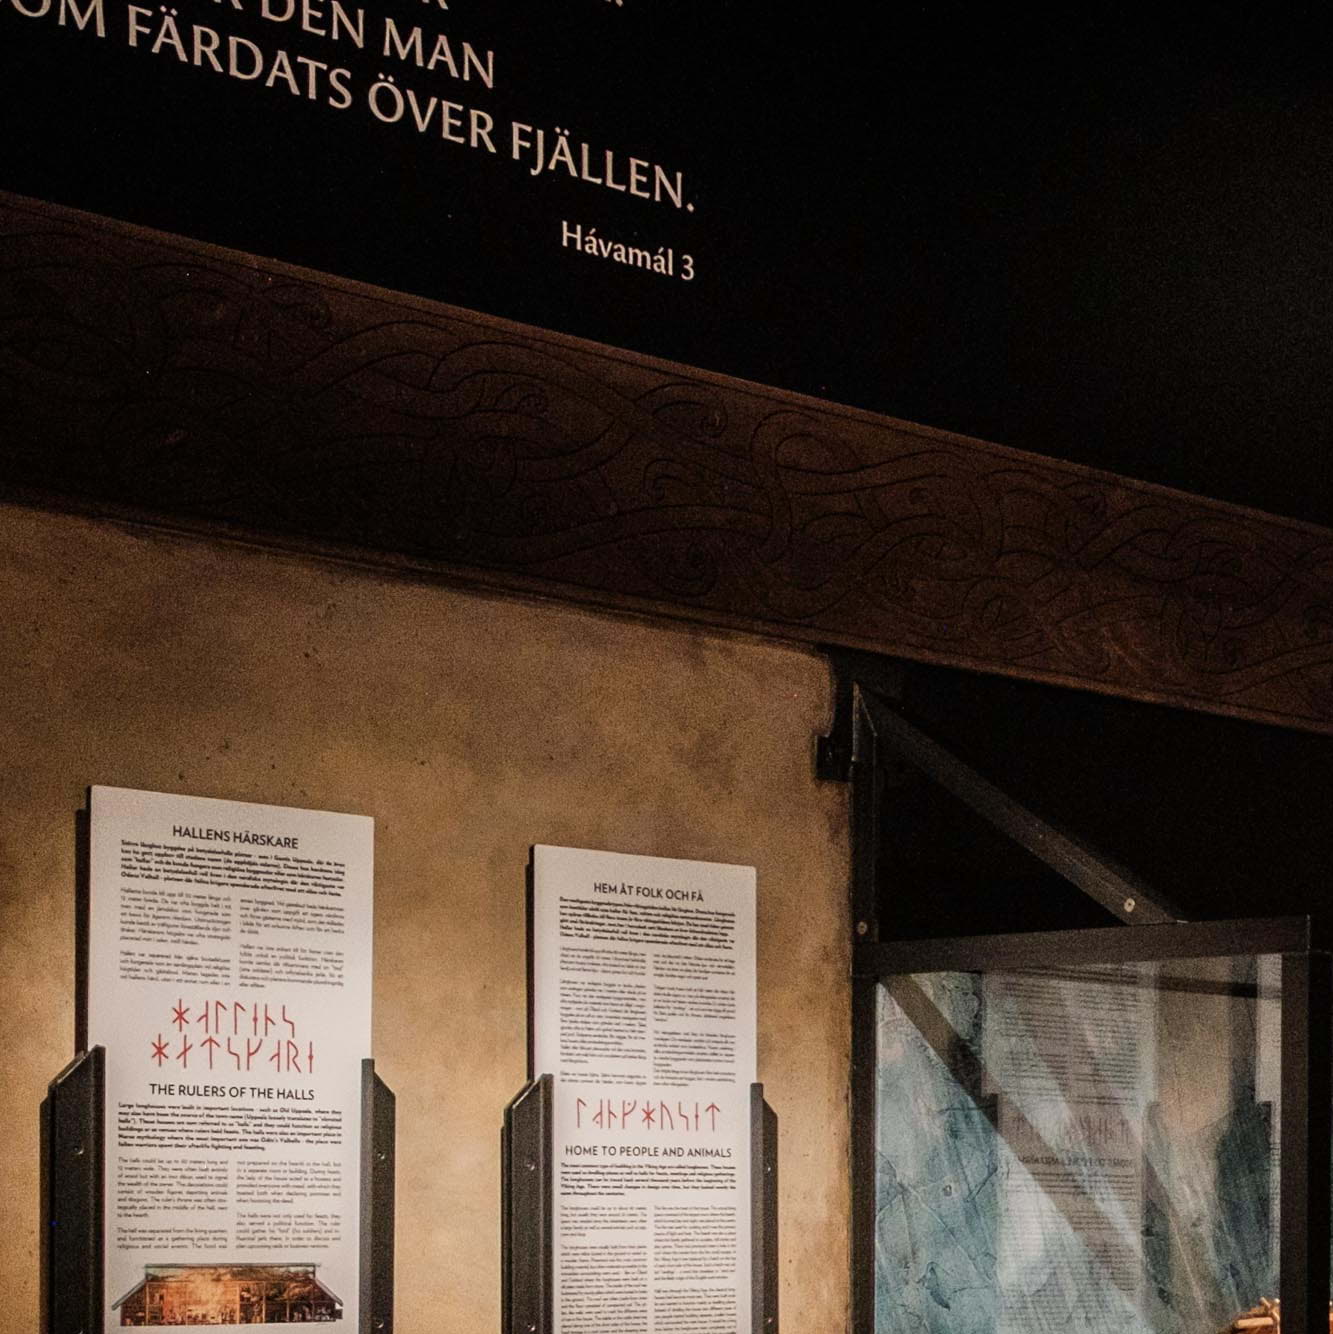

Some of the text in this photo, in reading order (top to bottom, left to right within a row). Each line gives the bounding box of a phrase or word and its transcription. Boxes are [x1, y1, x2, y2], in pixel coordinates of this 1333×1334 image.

[260, 0, 494, 88] DEN MAN
[128, 4, 353, 109] FÄRDATS
[369, 74, 496, 153] ÖVER
[512, 122, 695, 212] FJÄLLEN.
[562, 221, 695, 280] Hávamál 3
[172, 825, 299, 849] HALLENS HÄRSKARE
[594, 882, 618, 894] HEM
[620, 883, 634, 895] ÅT
[636, 887, 663, 898] FOLK
[666, 889, 689, 901] OCH
[149, 1083, 315, 1101] THE RULERS OF THE HALLS
[565, 1145, 732, 1158] HOME TO PEOPLE AND ANIMALS
